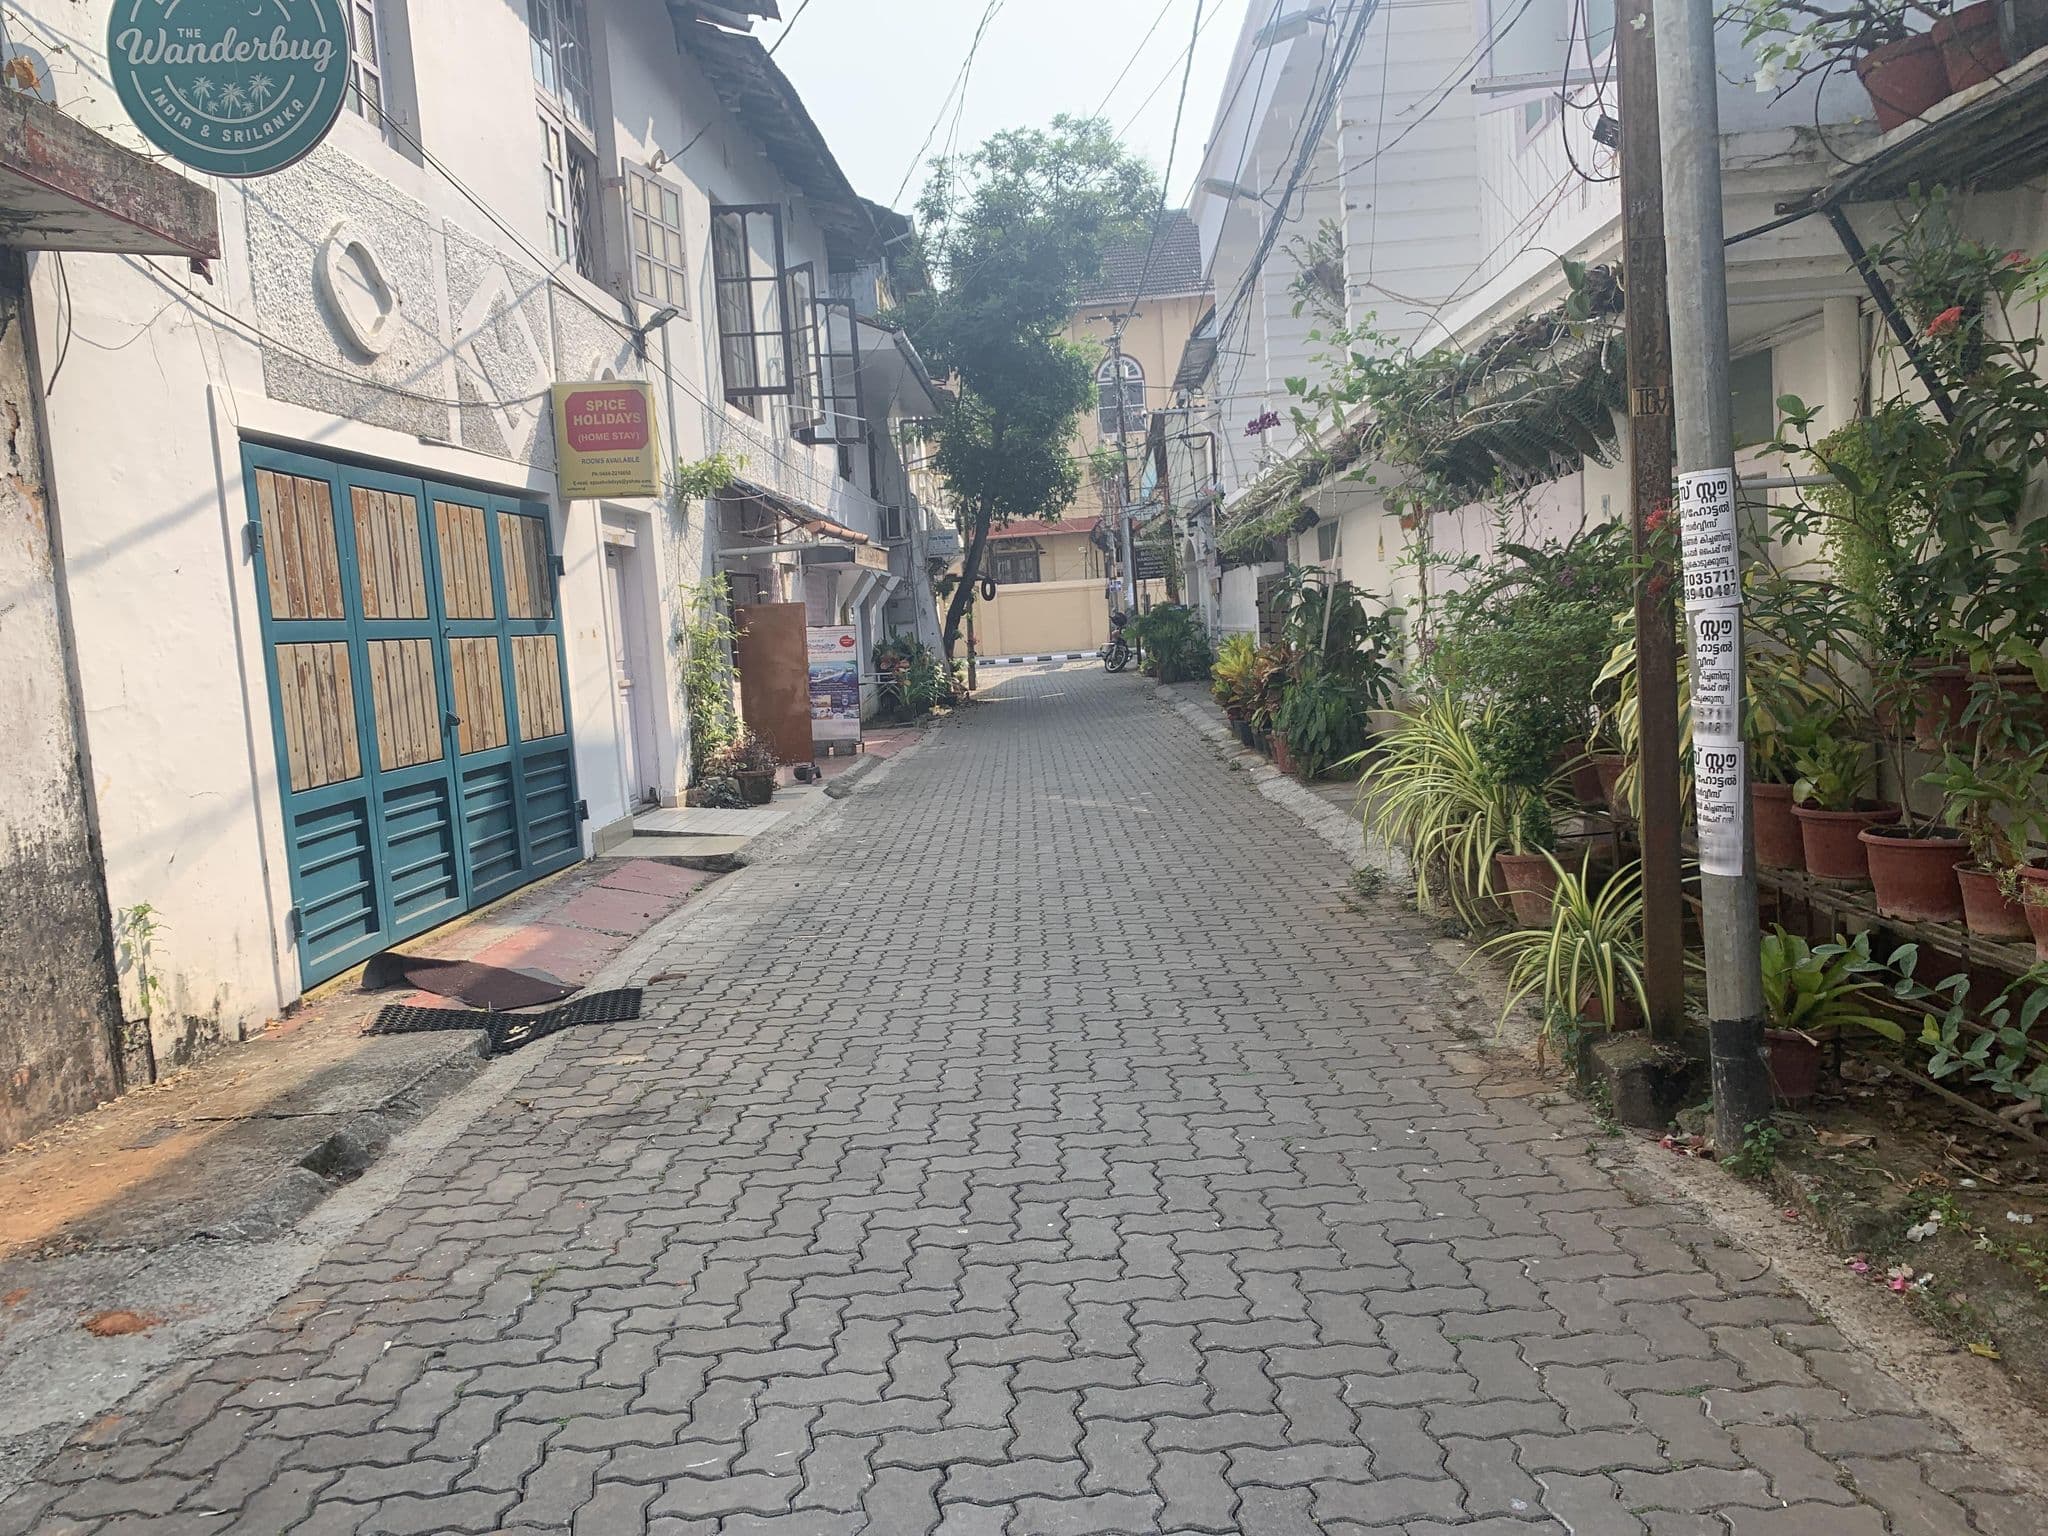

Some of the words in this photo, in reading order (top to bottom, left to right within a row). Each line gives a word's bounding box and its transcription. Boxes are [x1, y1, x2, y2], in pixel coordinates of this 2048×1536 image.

[177, 28, 201, 38] THE
[116, 25, 337, 73] Wanderbug
[150, 87, 192, 130] INDIA
[200, 124, 210, 138] &
[222, 98, 305, 143] SRILANKA
[585, 399, 627, 412] SPICE
[573, 412, 641, 426] HOLIDAYS
[578, 432, 610, 444] (HOME
[612, 431, 641, 441] STAY)
[605, 456, 641, 464] AVAILABLE
